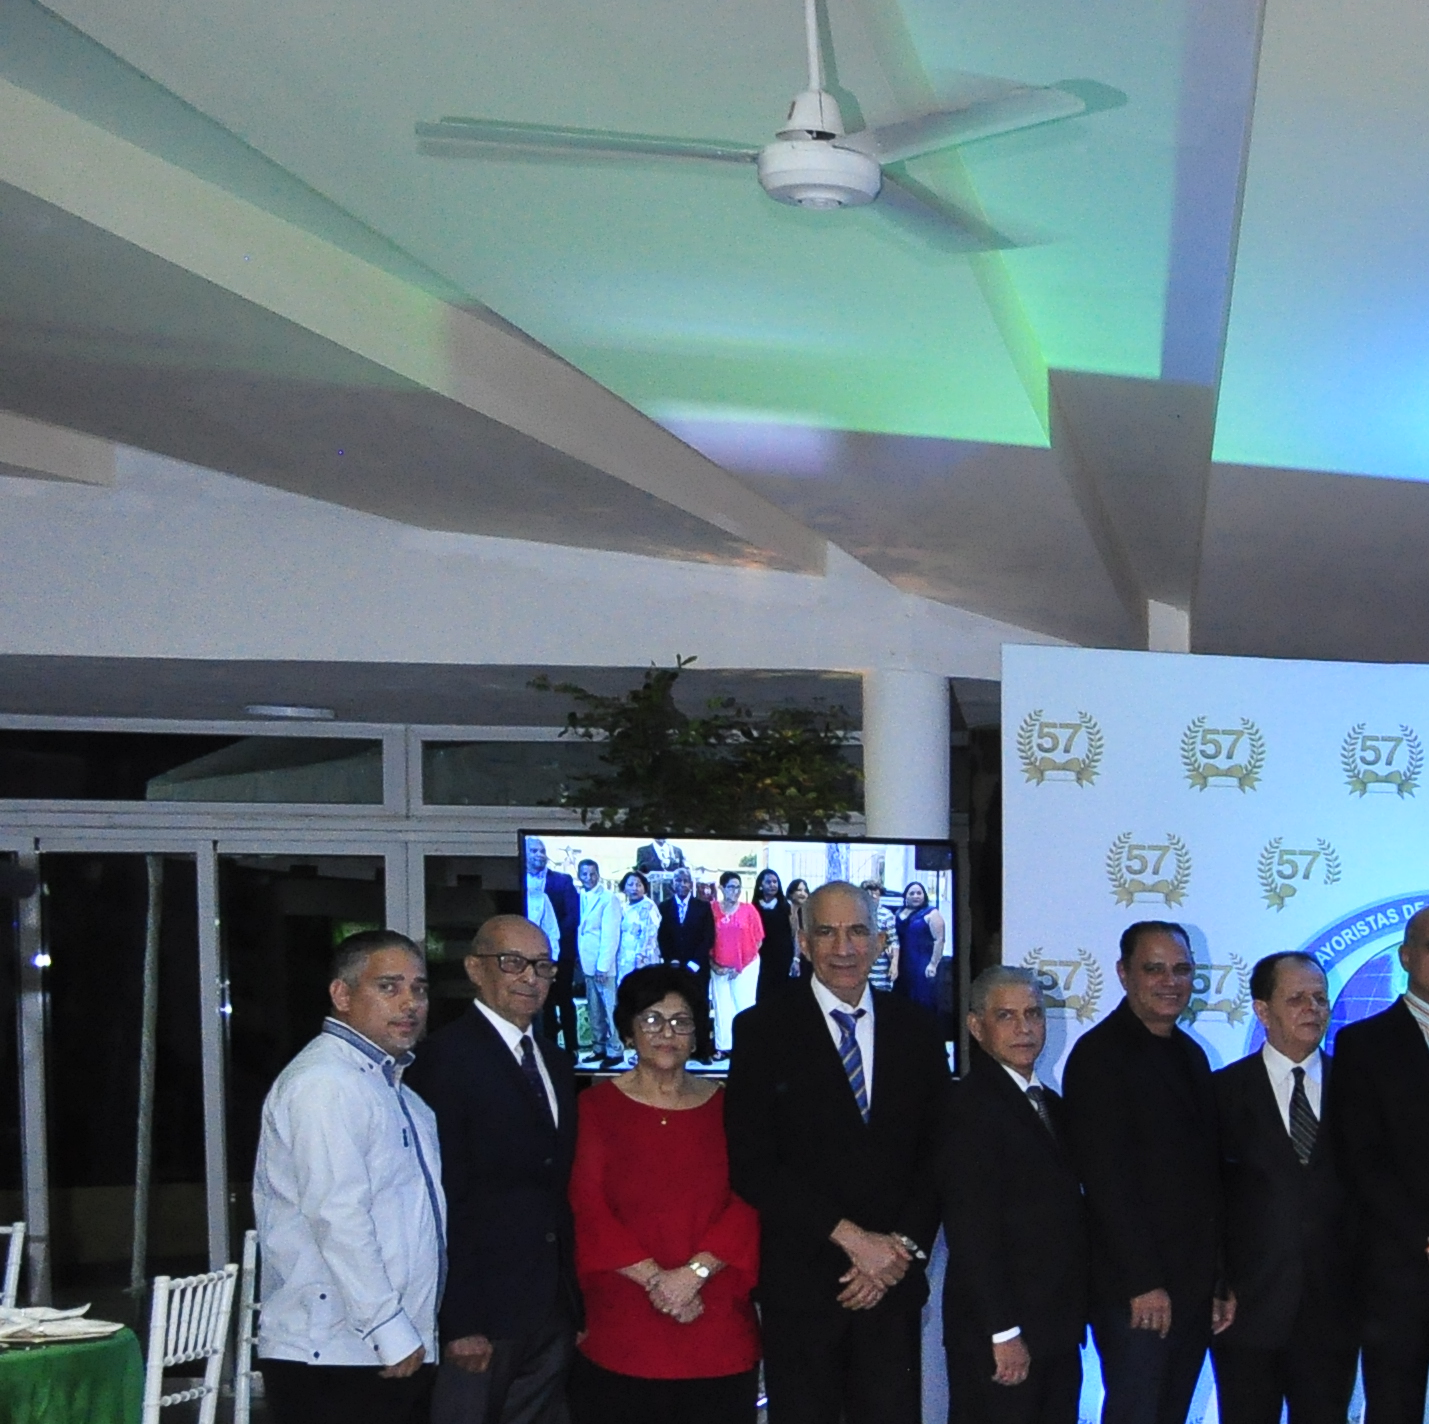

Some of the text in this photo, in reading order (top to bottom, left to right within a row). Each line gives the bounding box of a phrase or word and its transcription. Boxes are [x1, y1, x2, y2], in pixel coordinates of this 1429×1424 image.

[1036, 722, 1083, 754] 57
[1199, 729, 1245, 760] 57
[1359, 735, 1404, 767] 57
[1125, 844, 1171, 876] 57
[1276, 849, 1321, 881] 57
[1314, 908, 1400, 967] AYORISTAS
[1037, 959, 1083, 992] 57
